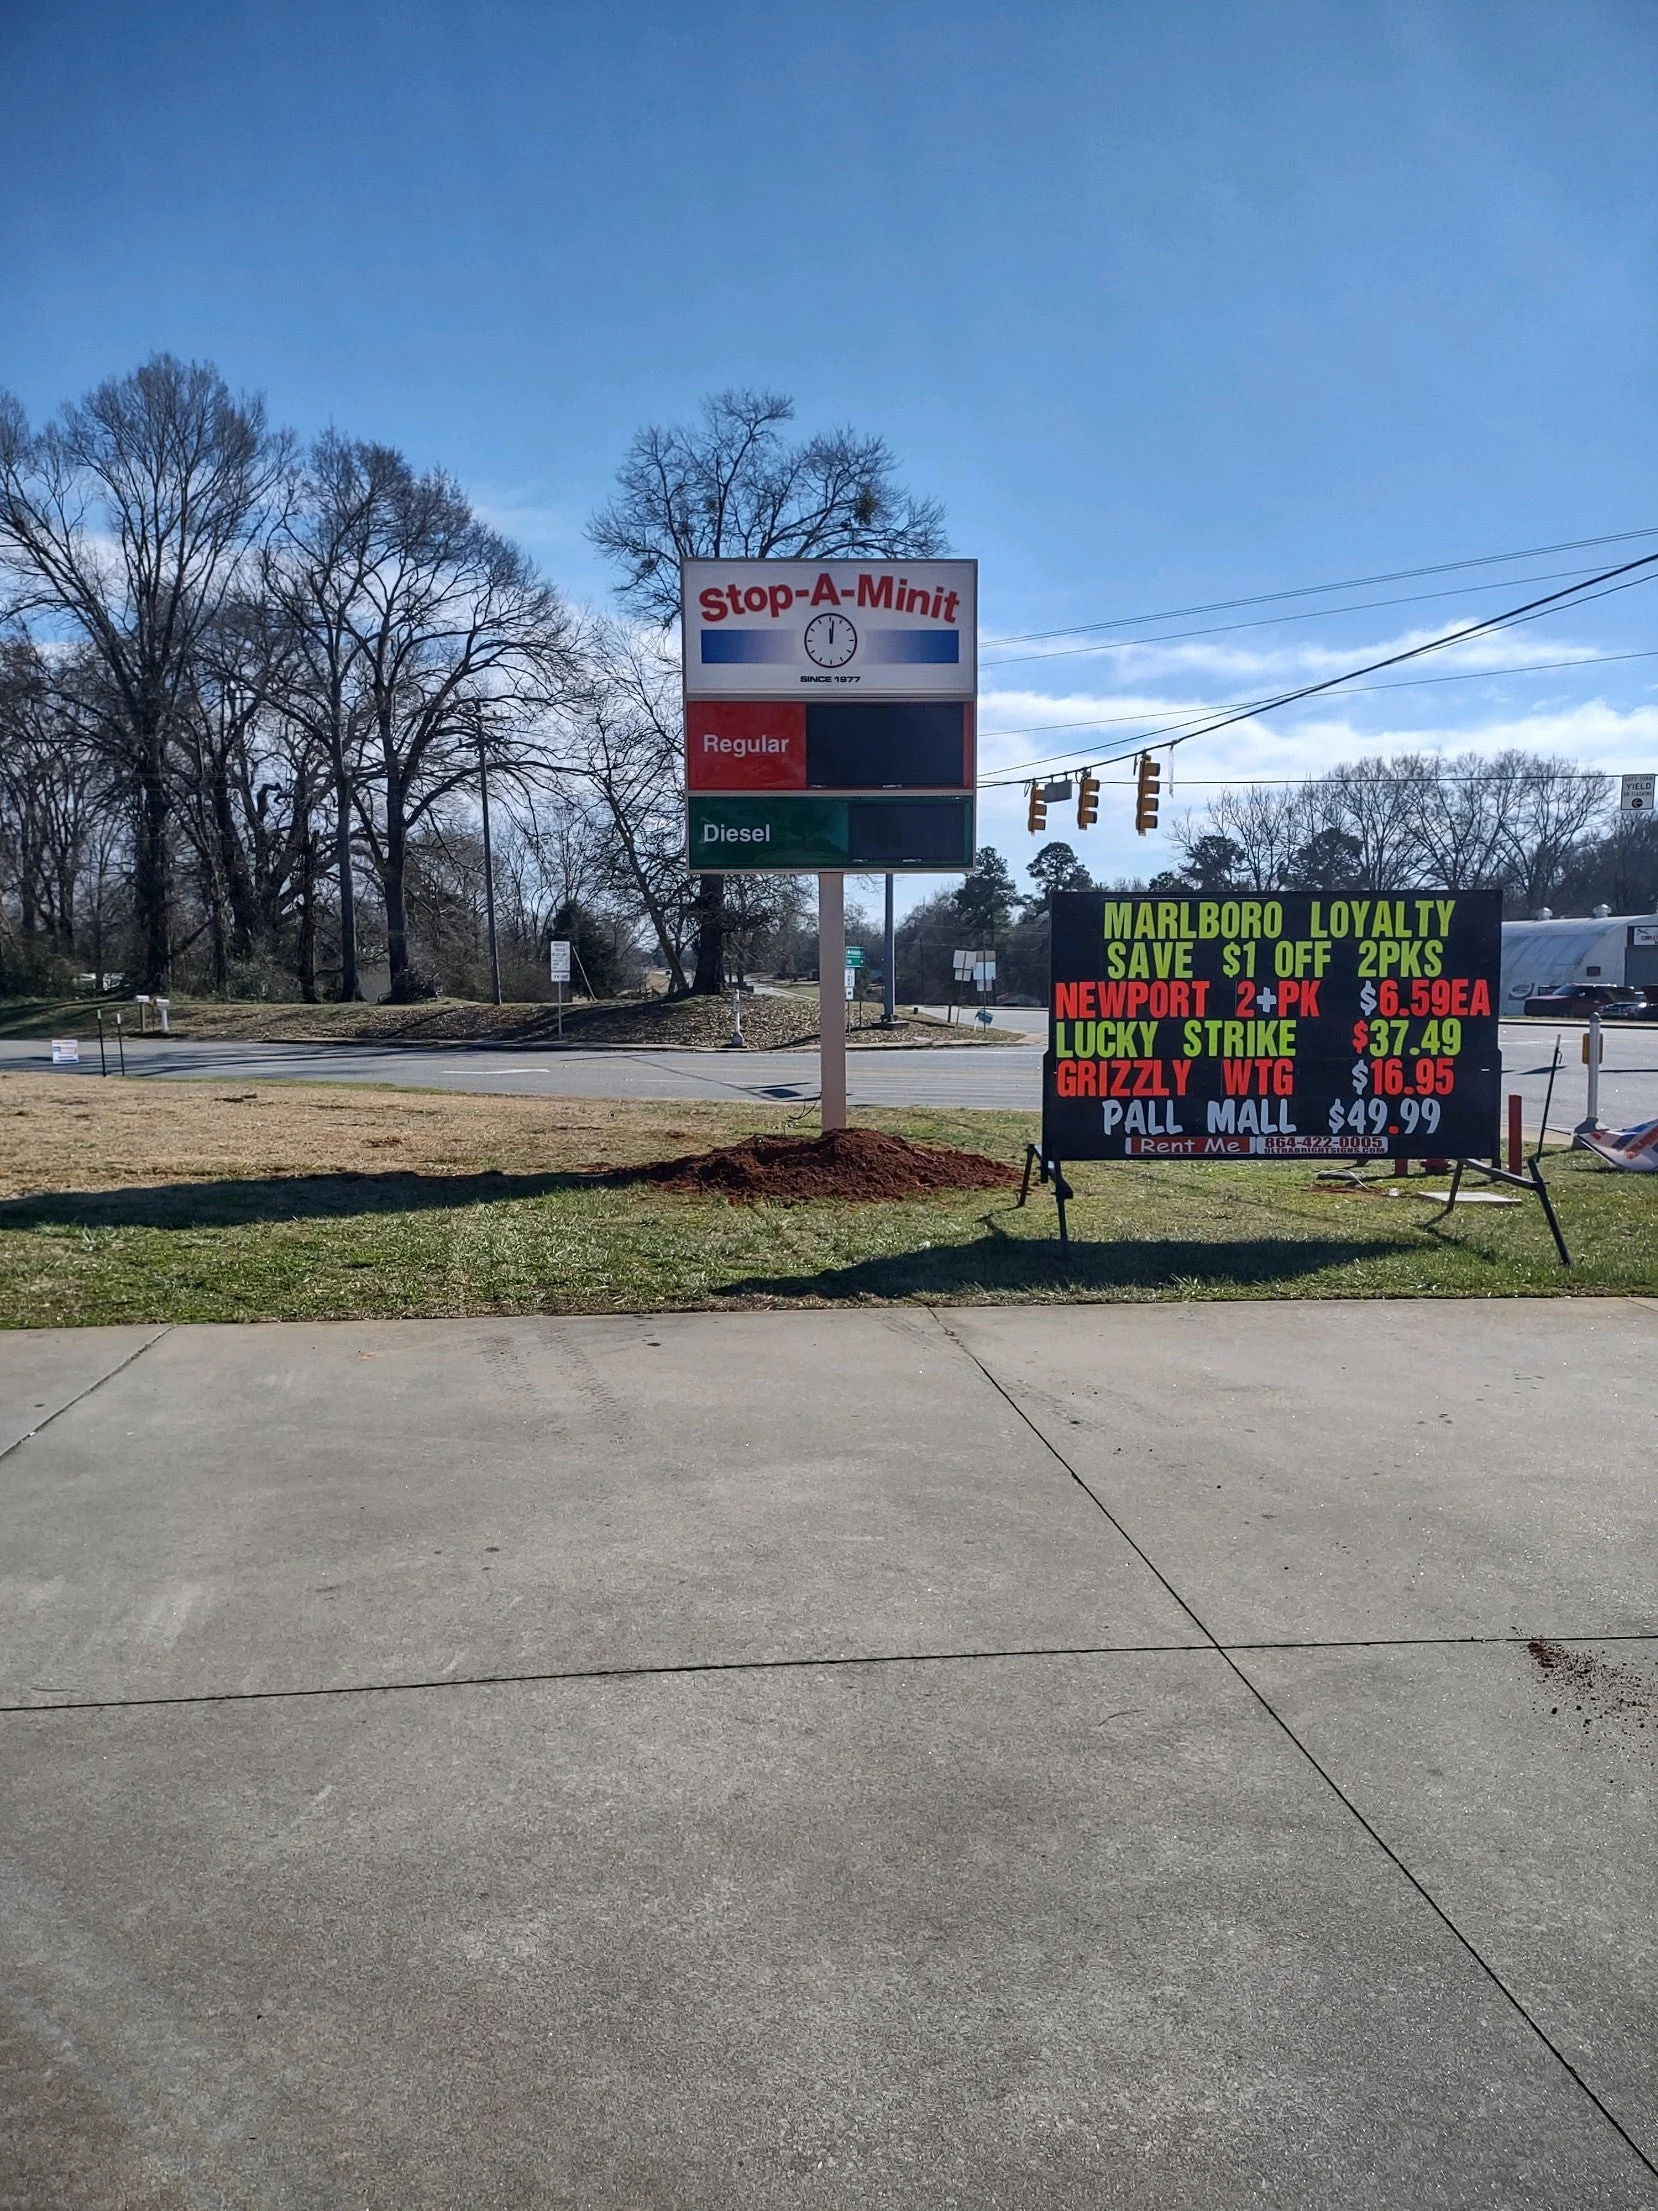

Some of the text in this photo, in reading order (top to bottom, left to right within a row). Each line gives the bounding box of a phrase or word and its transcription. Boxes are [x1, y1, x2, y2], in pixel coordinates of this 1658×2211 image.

[699, 573, 960, 623] Stop-A-Minit
[703, 734, 789, 757] Regular
[703, 823, 770, 843] Diesel
[1104, 900, 1456, 939] MARLBORO LOYALTY
[1107, 940, 1444, 979] SAVE $1 OFF 2PKS
[1055, 979, 1491, 1019] NEWPORT 2+PK $6.59EA
[1056, 1019, 1462, 1059] LUCKY STRIKE $37.49
[1057, 1058, 1455, 1097] GRIZZLY WTG $16.95
[1102, 1098, 1441, 1136] PALL MALL $49.99
[1140, 1138, 1240, 1153] Rent Me
[1264, 1137, 1383, 1148] 864-422-0005
